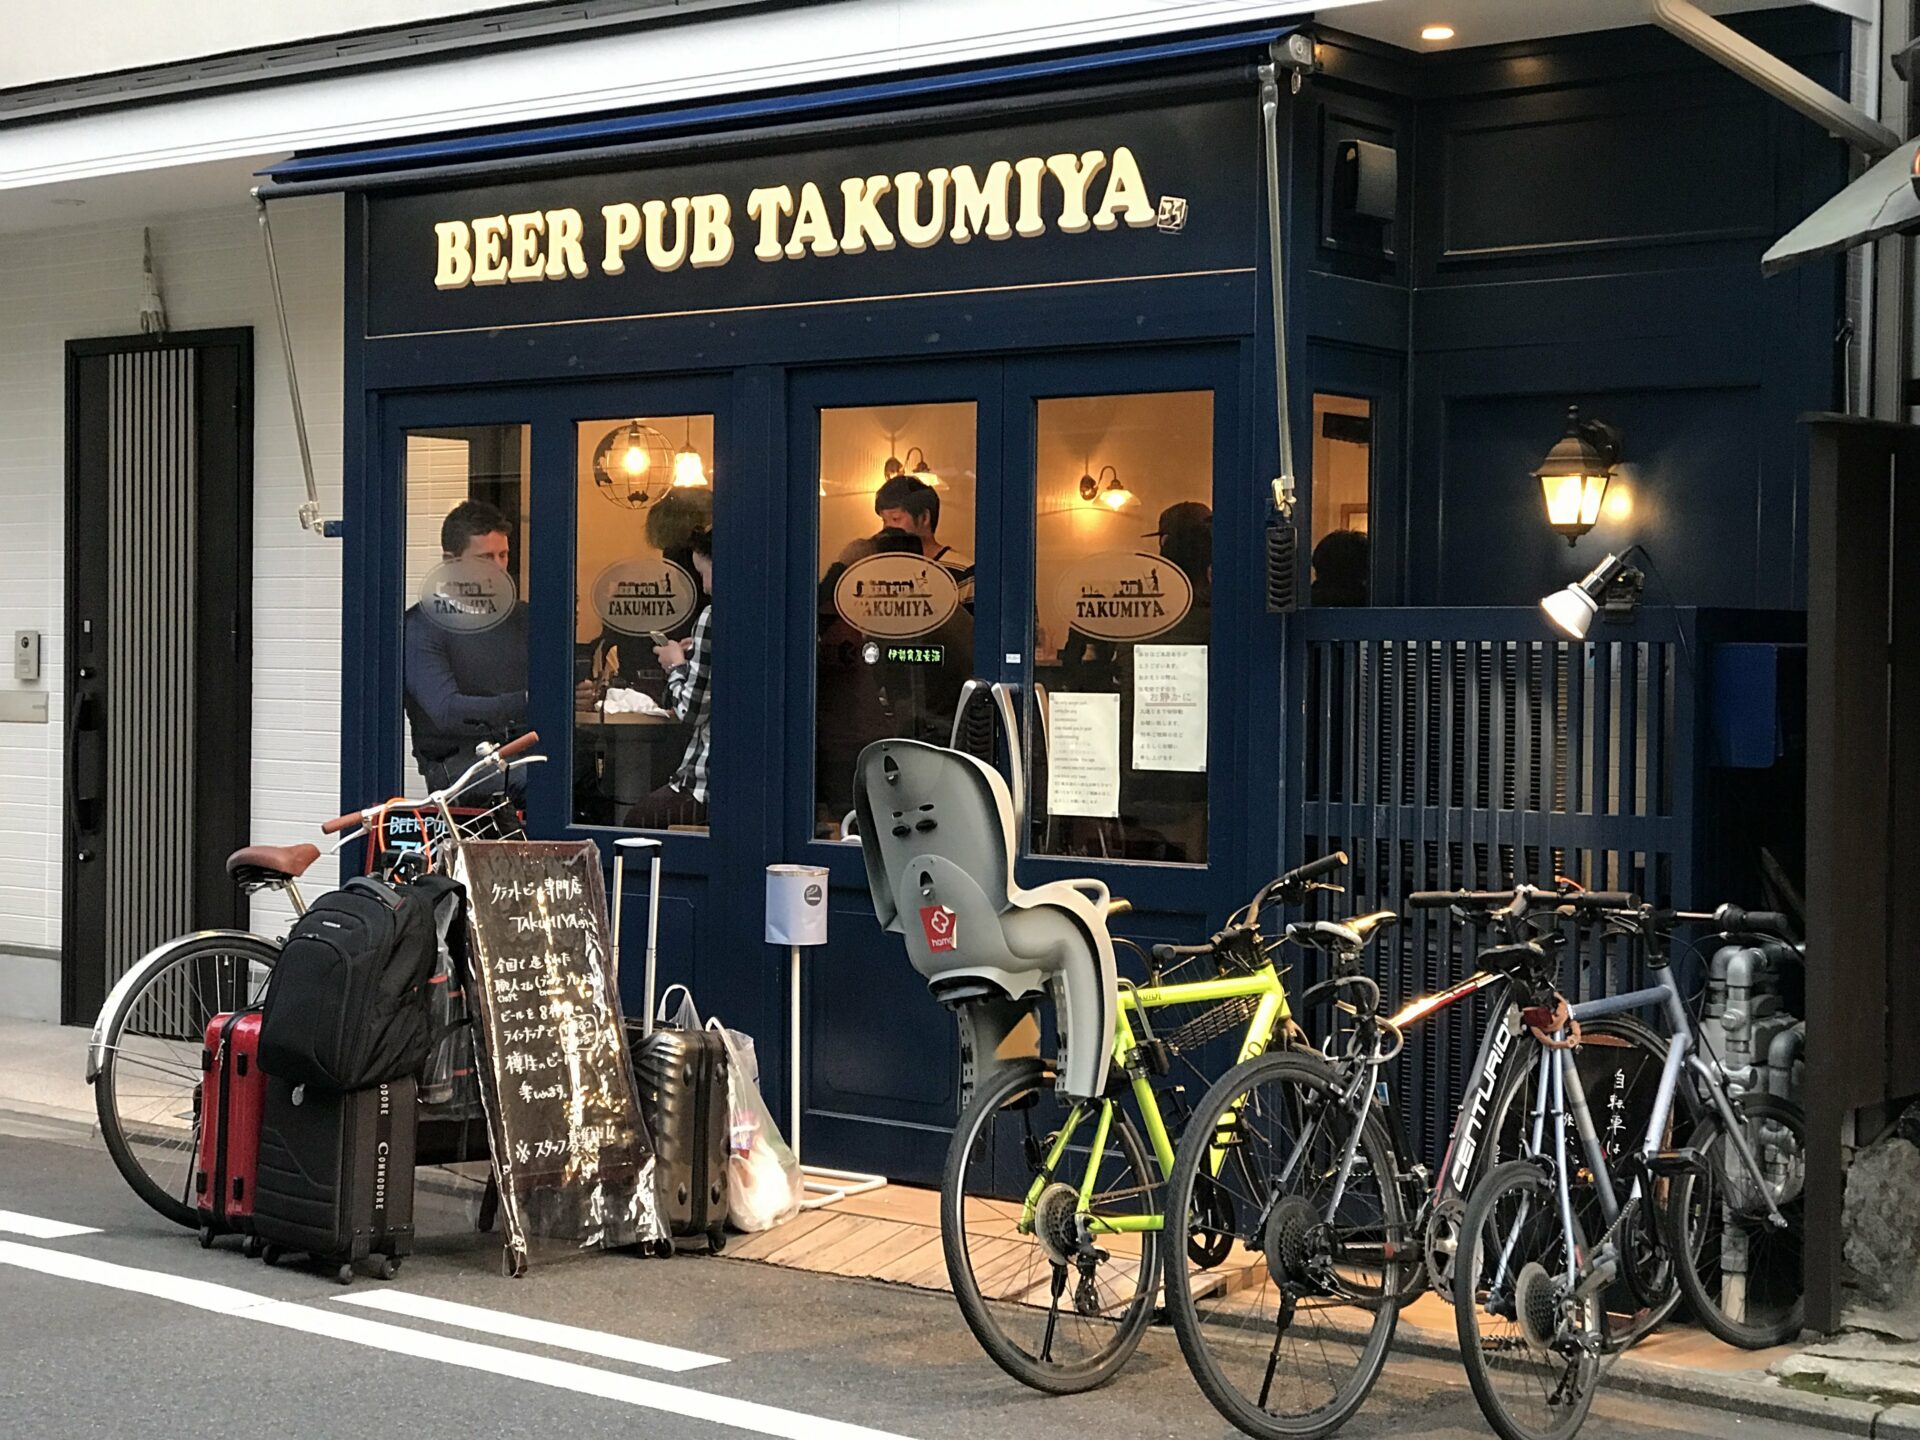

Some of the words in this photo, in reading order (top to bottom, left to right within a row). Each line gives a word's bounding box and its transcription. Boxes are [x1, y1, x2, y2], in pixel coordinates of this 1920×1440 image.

[434, 208, 588, 289] BEER
[601, 193, 735, 274] PUB
[747, 146, 1157, 260] TAKUMIYA
[608, 600, 676, 616] TAKUMIYA
[854, 600, 934, 617] AKUMIYA
[1076, 600, 1165, 618] TAKUMIYA
[389, 816, 422, 835] BEER
[380, 1083, 389, 1115] ODORE
